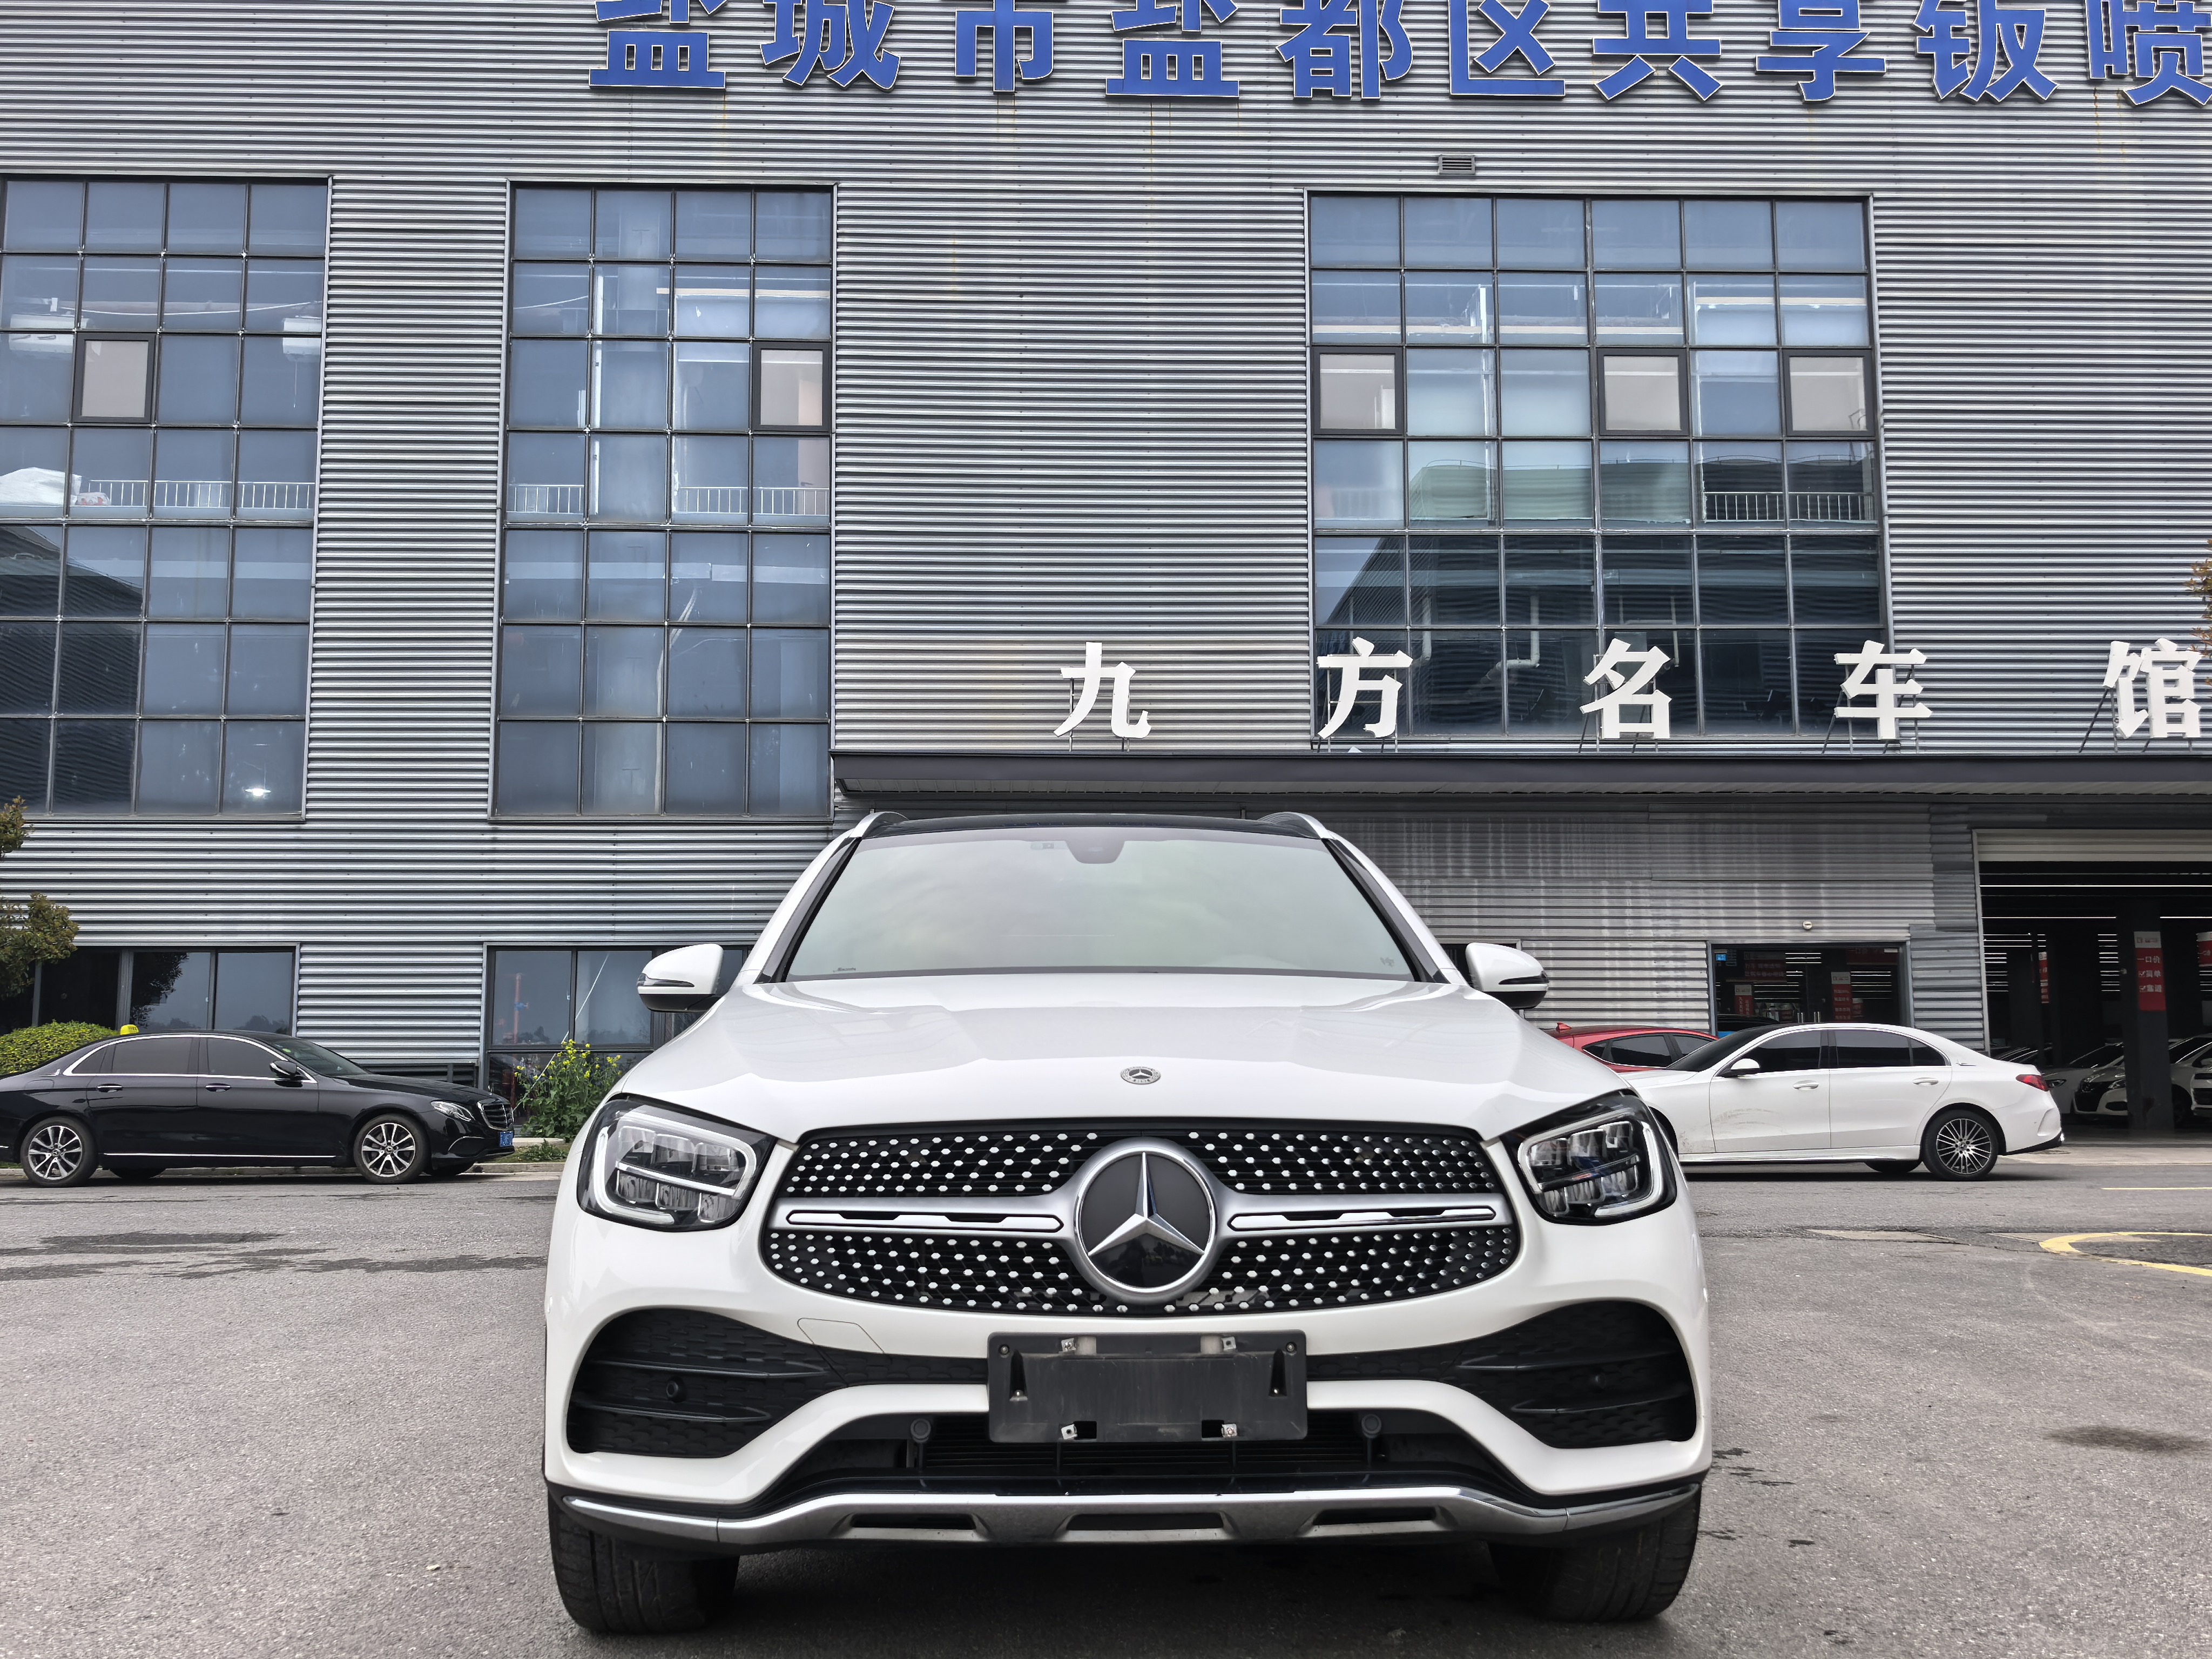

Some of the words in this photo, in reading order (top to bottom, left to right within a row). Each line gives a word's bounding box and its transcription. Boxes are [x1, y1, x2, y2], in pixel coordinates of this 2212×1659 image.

[589, 0, 2212, 106] 盐城市盐都区共享钣喷
[1054, 638, 2203, 740] 九方名车馆
